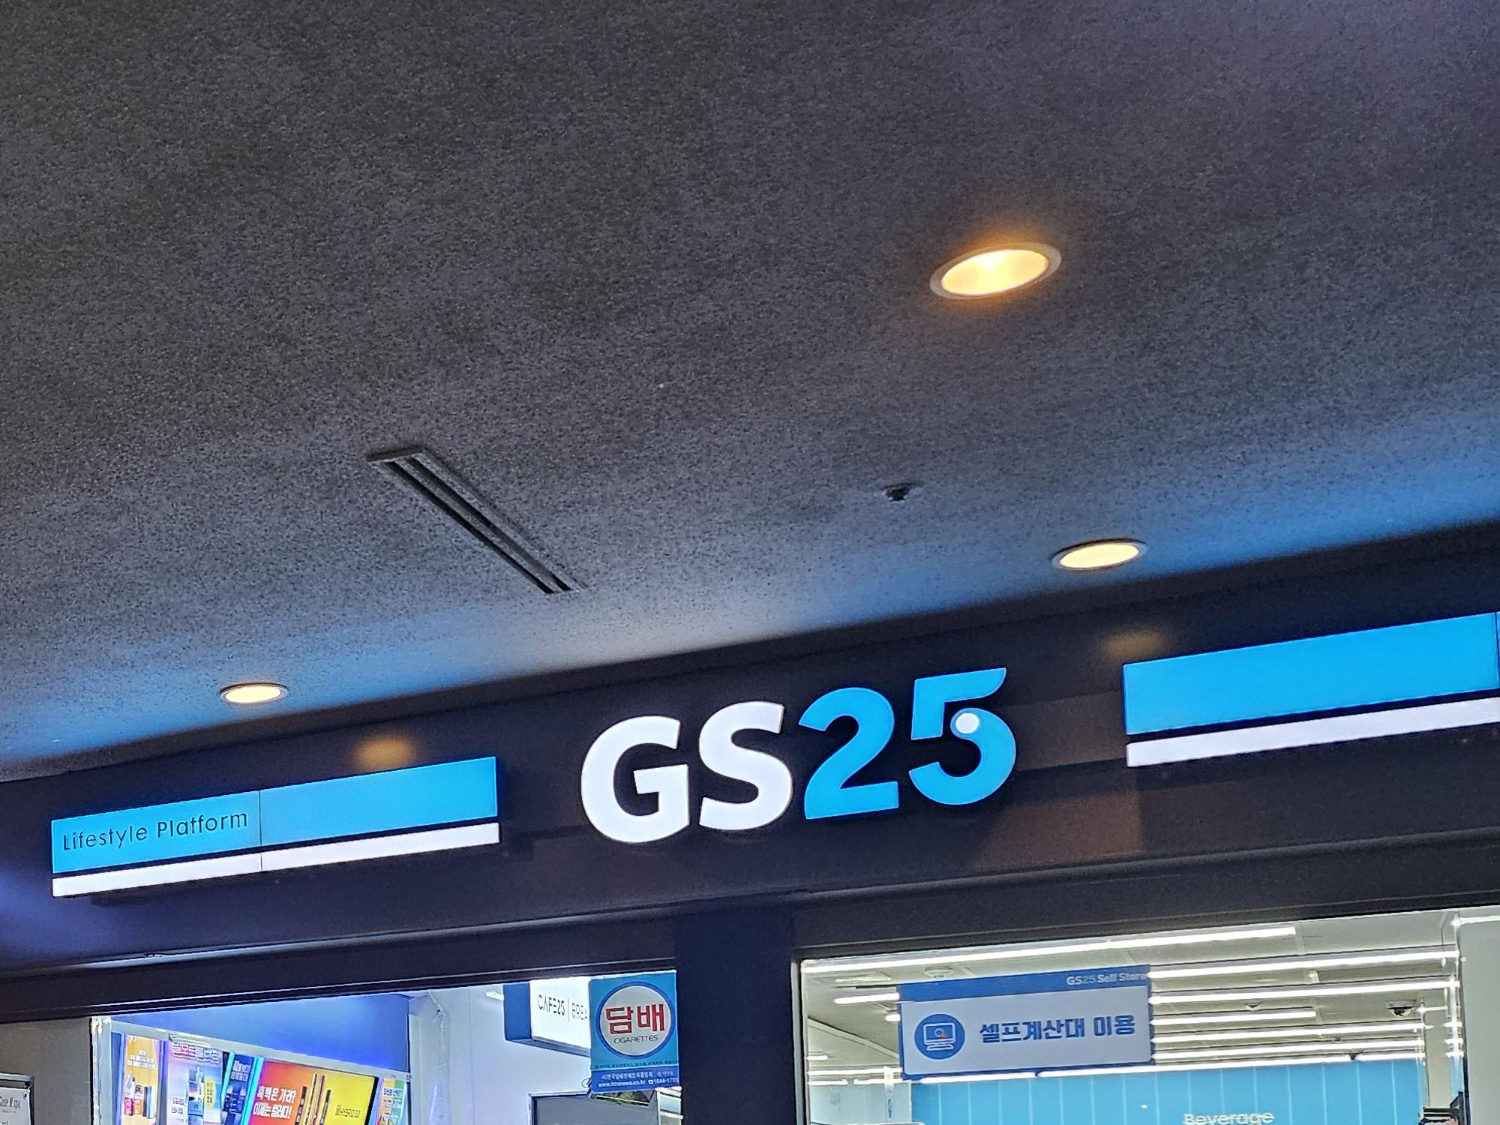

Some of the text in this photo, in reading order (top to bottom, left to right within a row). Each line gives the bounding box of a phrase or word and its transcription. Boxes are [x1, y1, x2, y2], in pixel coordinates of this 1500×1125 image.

[581, 668, 1017, 843] GS25
[63, 809, 248, 850] Lifestyle Platform
[605, 1003, 665, 1035] 담배
[979, 1014, 1136, 1044] 셀프계산대 이용
